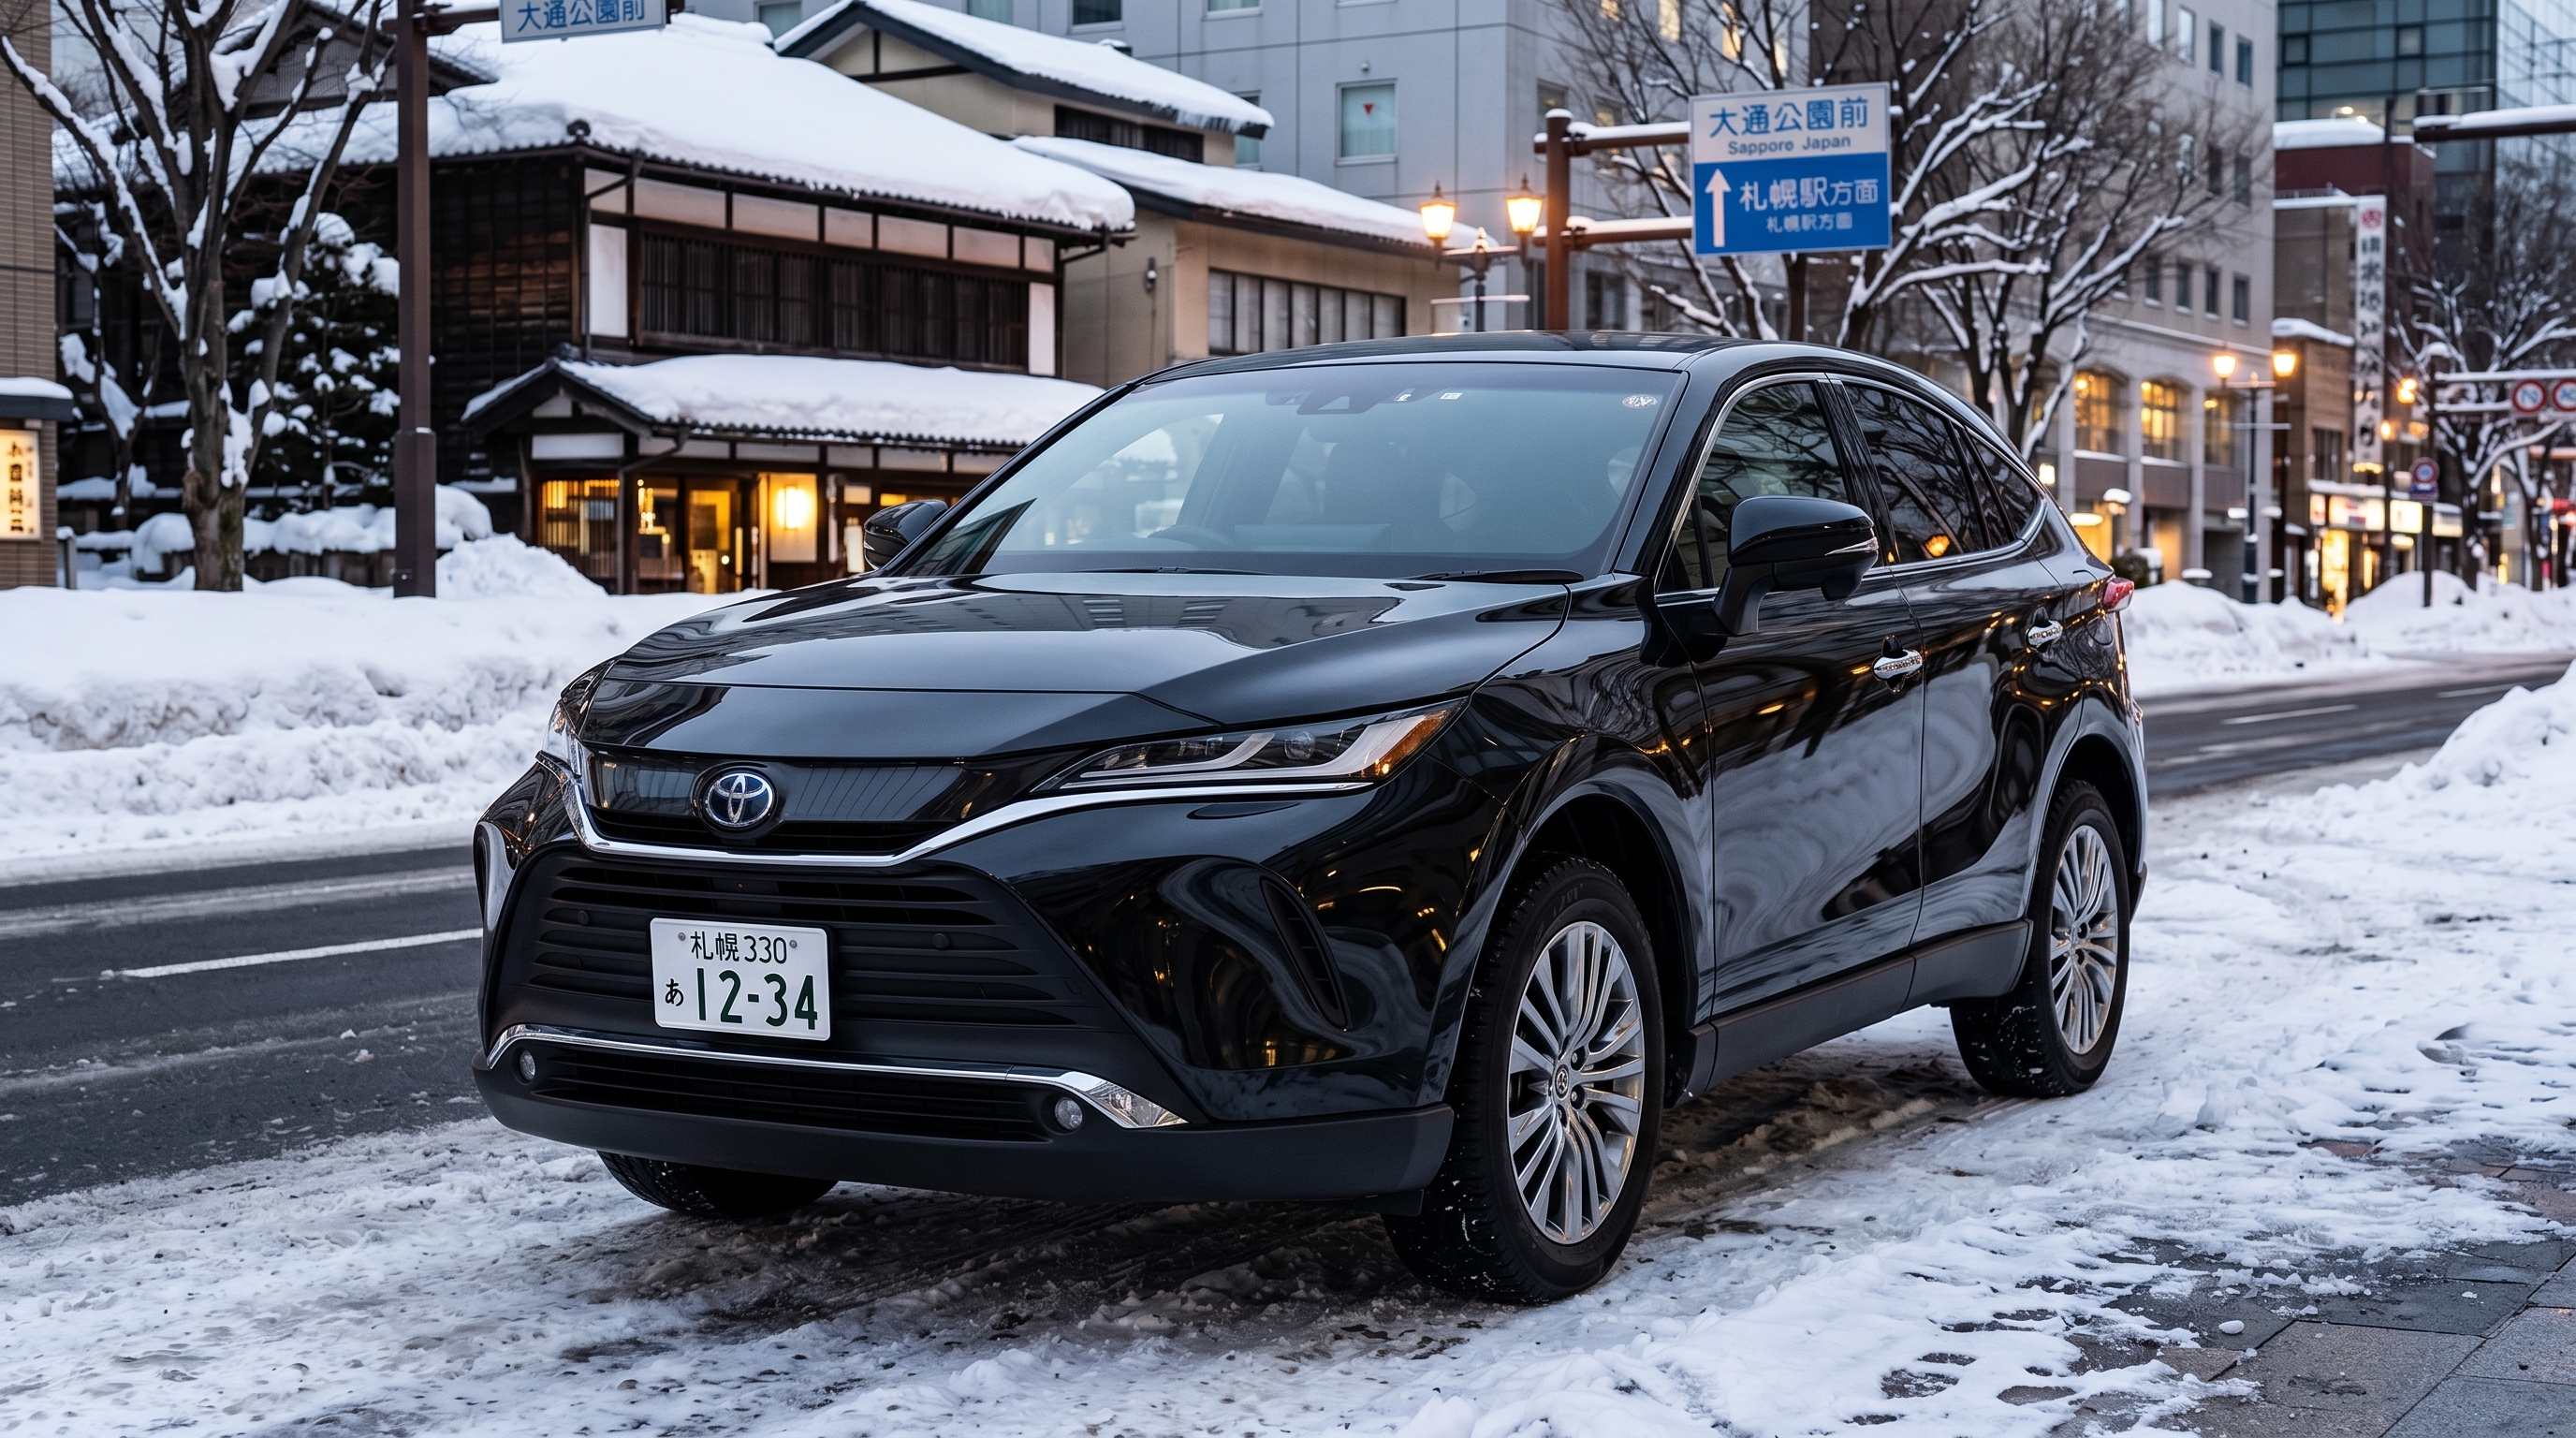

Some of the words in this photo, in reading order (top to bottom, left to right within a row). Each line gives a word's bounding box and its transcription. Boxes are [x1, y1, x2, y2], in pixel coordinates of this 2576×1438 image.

[1709, 96, 1868, 138] 大通公園前
[1802, 136, 1852, 152] Japan
[1739, 176, 1879, 212] 札幌駅方面
[690, 931, 739, 961] 札幌
[743, 935, 787, 964] 330
[665, 977, 684, 1006] あ
[696, 967, 818, 1031] 12-34
